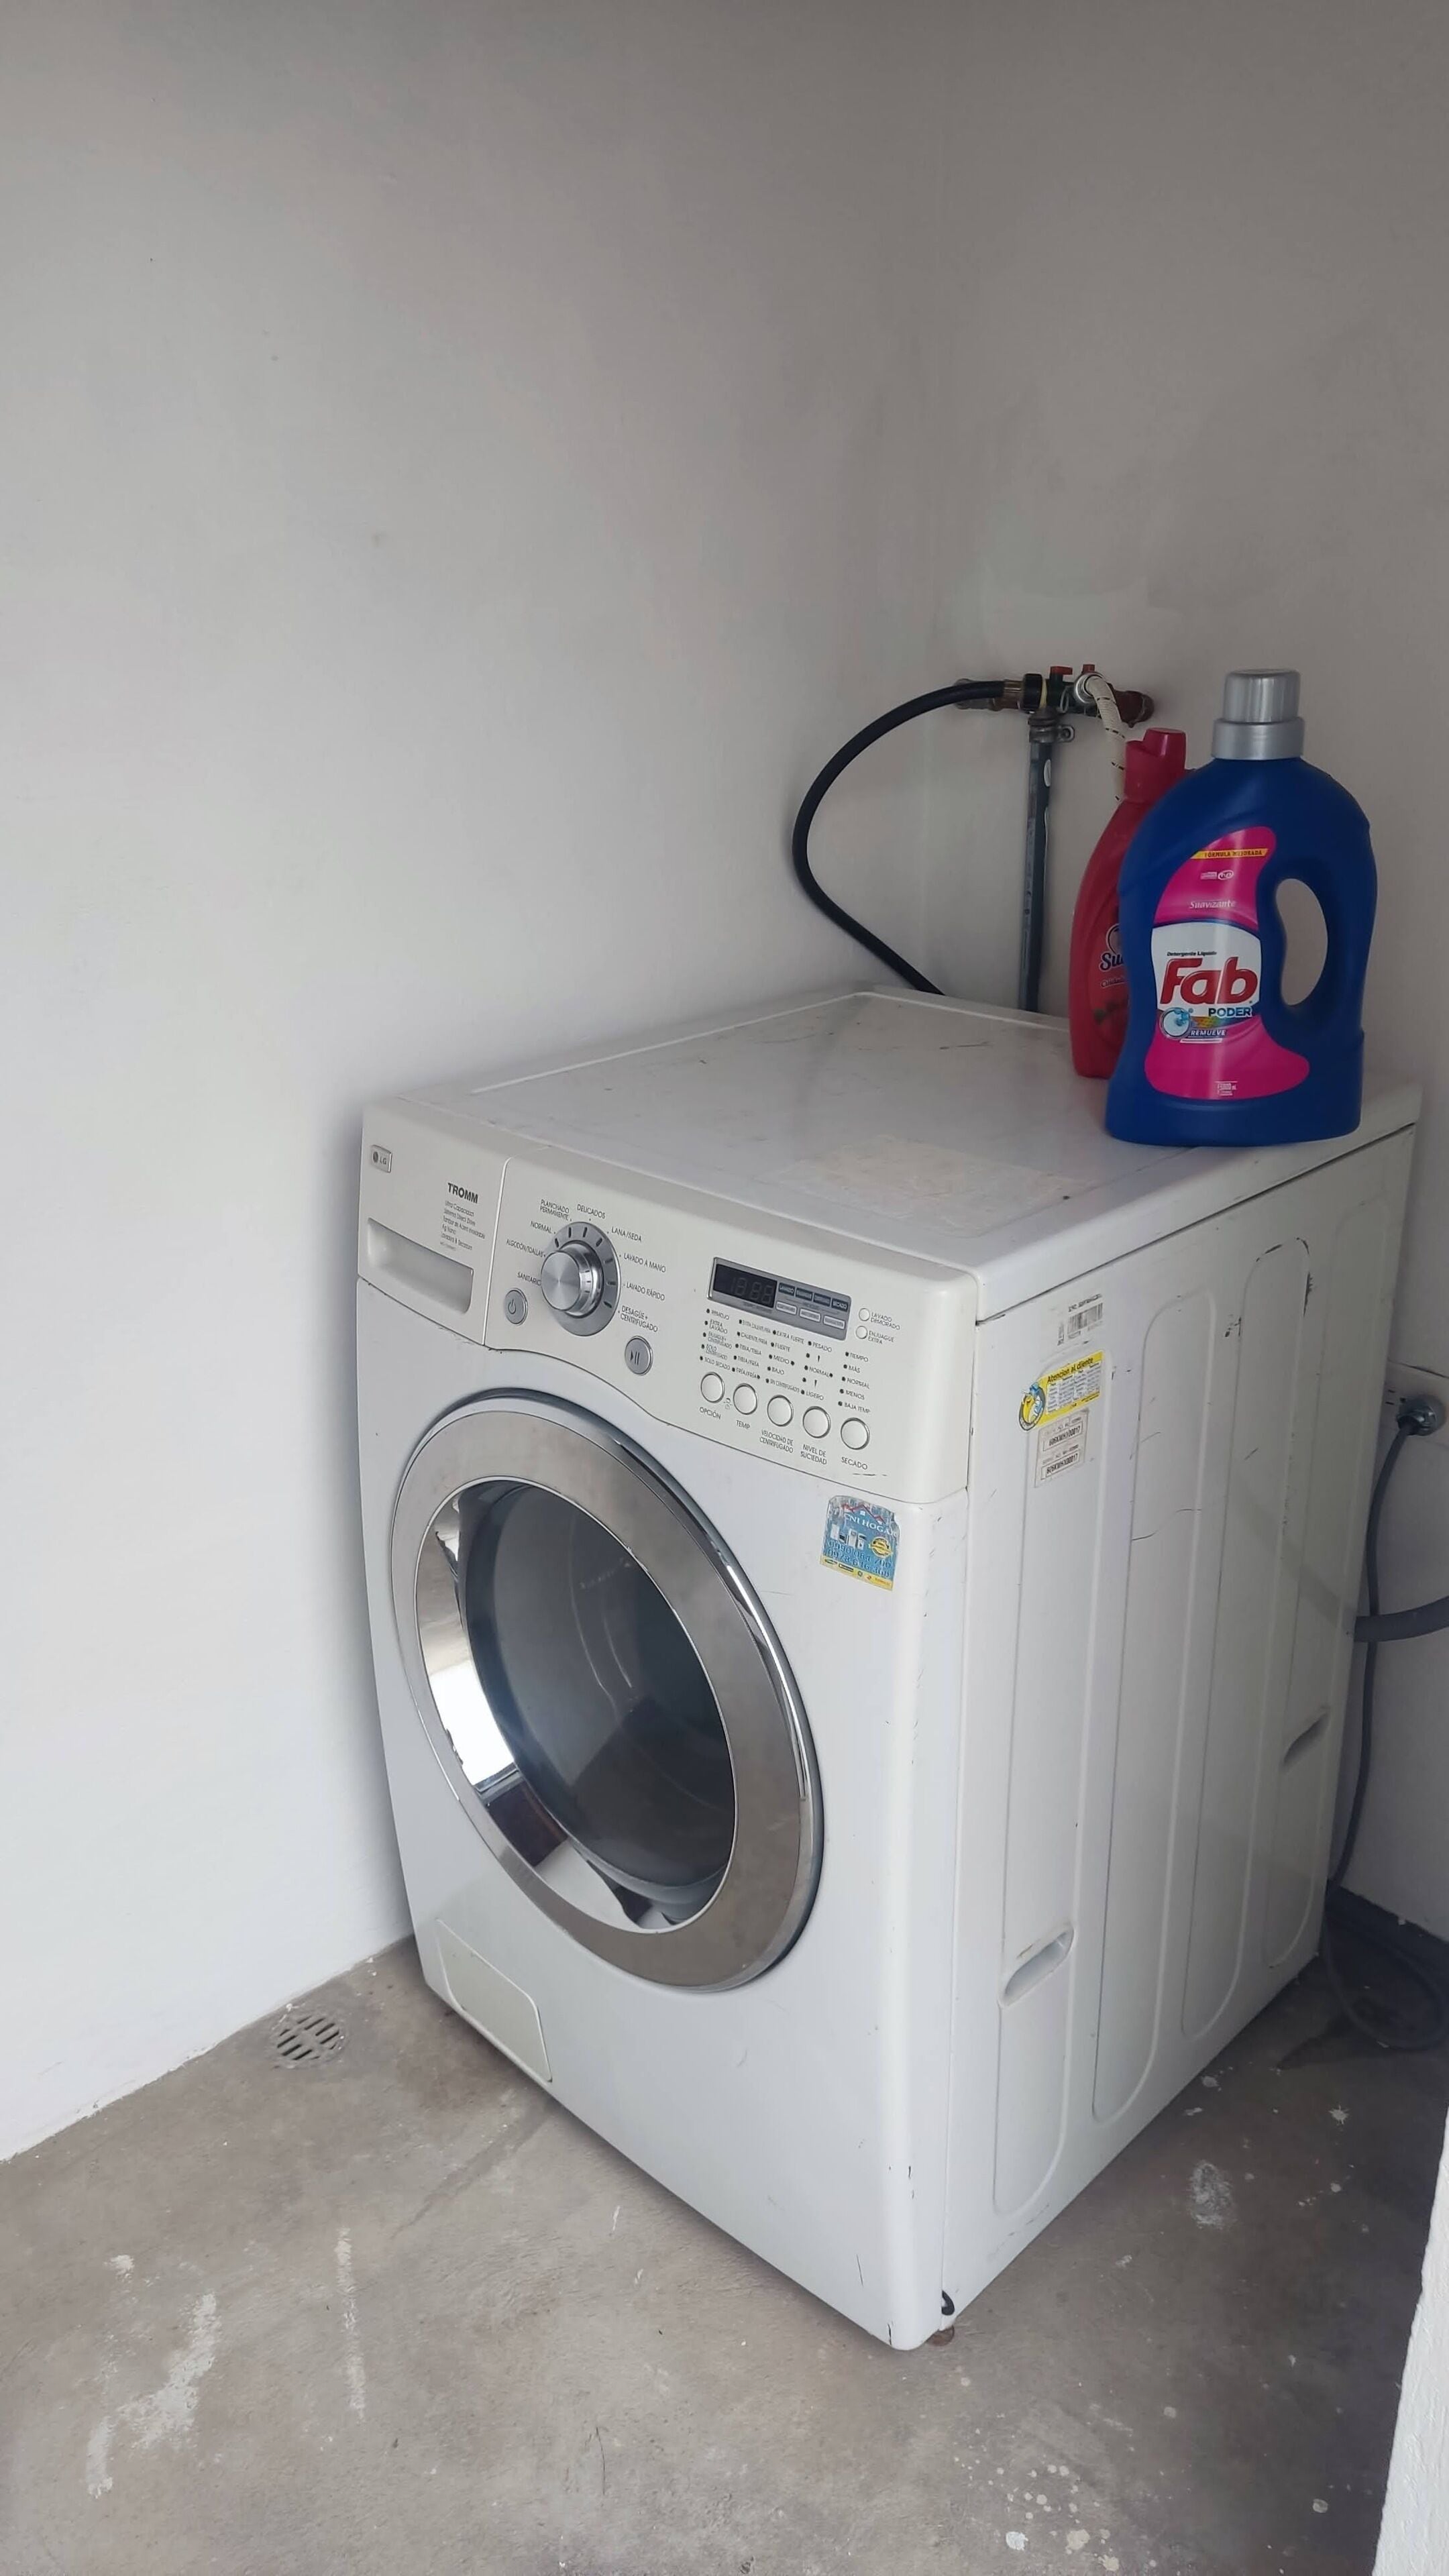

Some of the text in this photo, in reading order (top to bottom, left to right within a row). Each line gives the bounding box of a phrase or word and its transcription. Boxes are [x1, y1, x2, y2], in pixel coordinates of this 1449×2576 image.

[1189, 899, 1236, 910] Suavizante
[1160, 957, 1258, 1004] Fab
[1208, 1007, 1252, 1017] PODER
[447, 1182, 478, 1204] TROMM
[541, 1199, 570, 1214] PLANCHADO
[577, 1204, 606, 1220] DELICADOS
[540, 1206, 569, 1222] PERMANENTE
[530, 1220, 552, 1234] NORMAL
[611, 1226, 642, 1242] LANA/SEDA
[623, 1252, 644, 1266] LAVADO
[649, 1260, 666, 1273] MANO
[626, 1281, 665, 1301] LAVADO RÁPIDO
[621, 1313, 658, 1333] CENTRIFUGADO
[774, 1342, 791, 1352] FUERTE
[812, 1342, 833, 1353] PESADO
[773, 1354, 790, 1364] MEDIO
[849, 1352, 869, 1362] TIEMPO
[771, 1366, 785, 1375] BAJO
[809, 1366, 829, 1378] NORMAL
[847, 1377, 871, 1389] NORMAL
[806, 1391, 824, 1401] LIGERO
[845, 1389, 865, 1401] MENOS
[699, 1406, 722, 1420] OPCIÓN
[735, 1419, 751, 1430] TEMP
[761, 1429, 794, 1446] VELOCIDAD DE
[759, 1436, 794, 1454] CENTRIFUGADO
[802, 1443, 826, 1458] NIVEL DE
[800, 1450, 828, 1466] SUCIEDAD
[841, 1456, 869, 1470] SECADO
